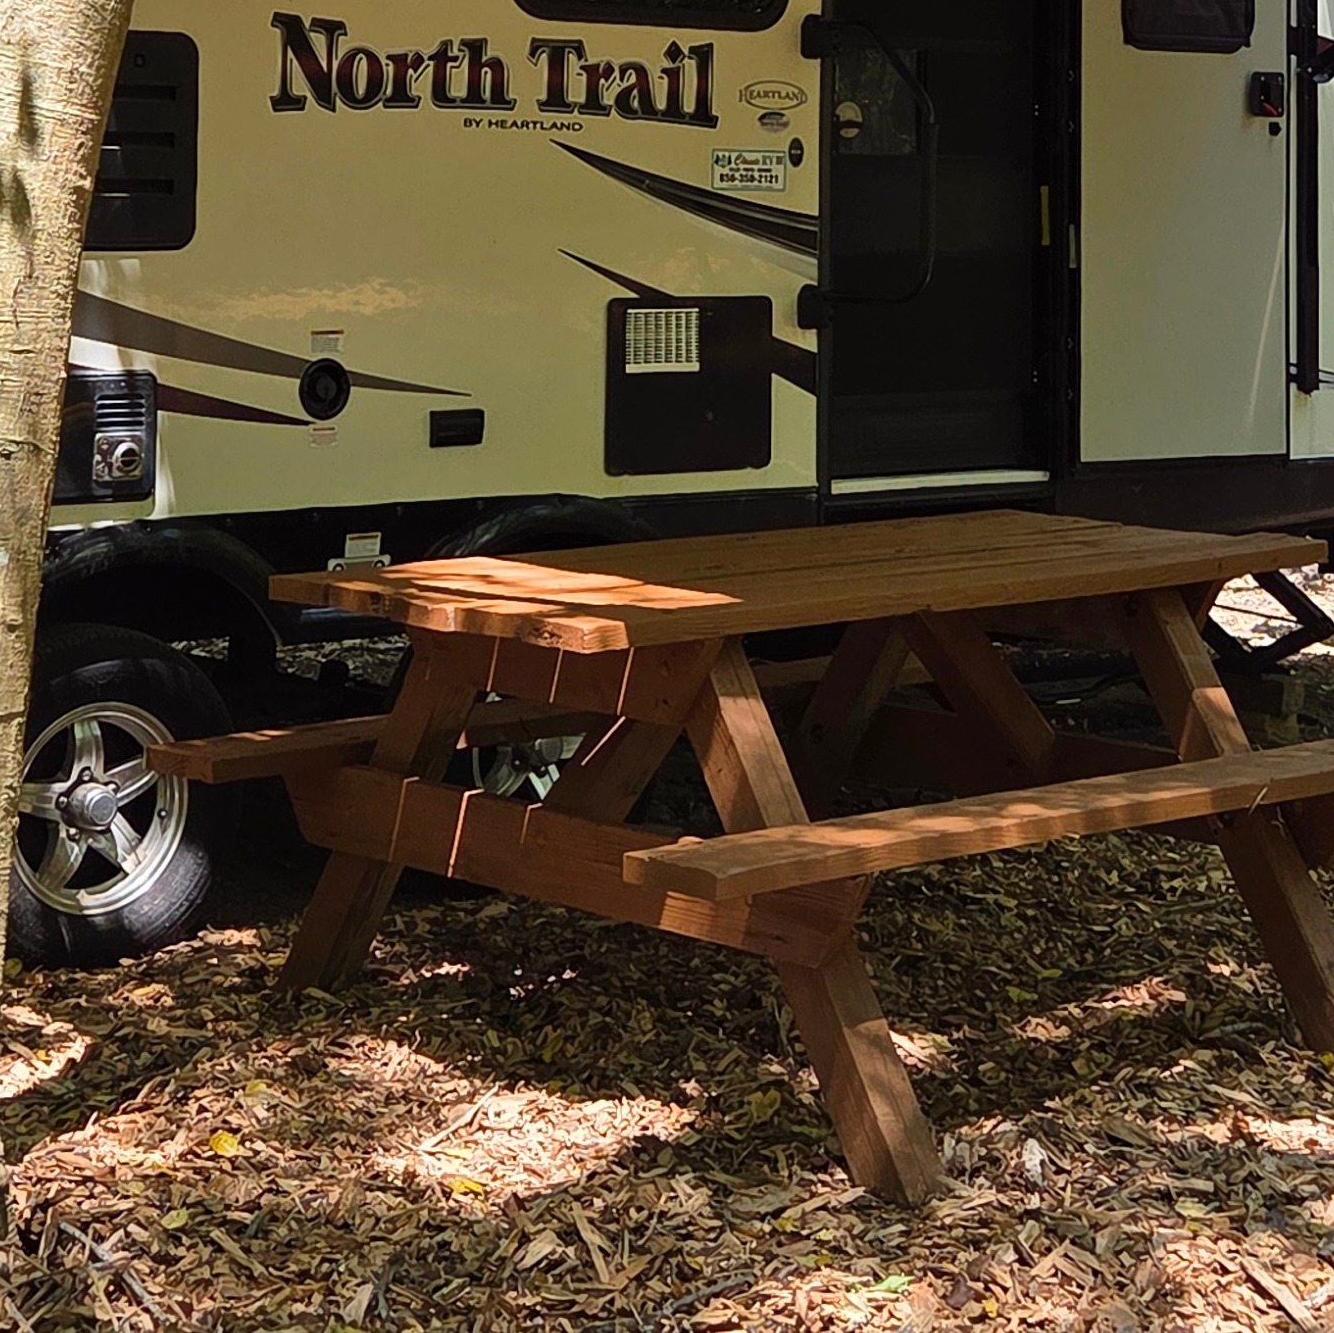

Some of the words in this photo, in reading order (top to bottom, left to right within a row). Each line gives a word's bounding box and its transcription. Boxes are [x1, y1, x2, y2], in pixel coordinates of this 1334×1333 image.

[269, 11, 516, 113] North
[526, 36, 719, 129] Trail
[738, 88, 808, 104] HEARTLAND
[463, 117, 484, 128] BY
[487, 118, 584, 132] HEARTLAND
